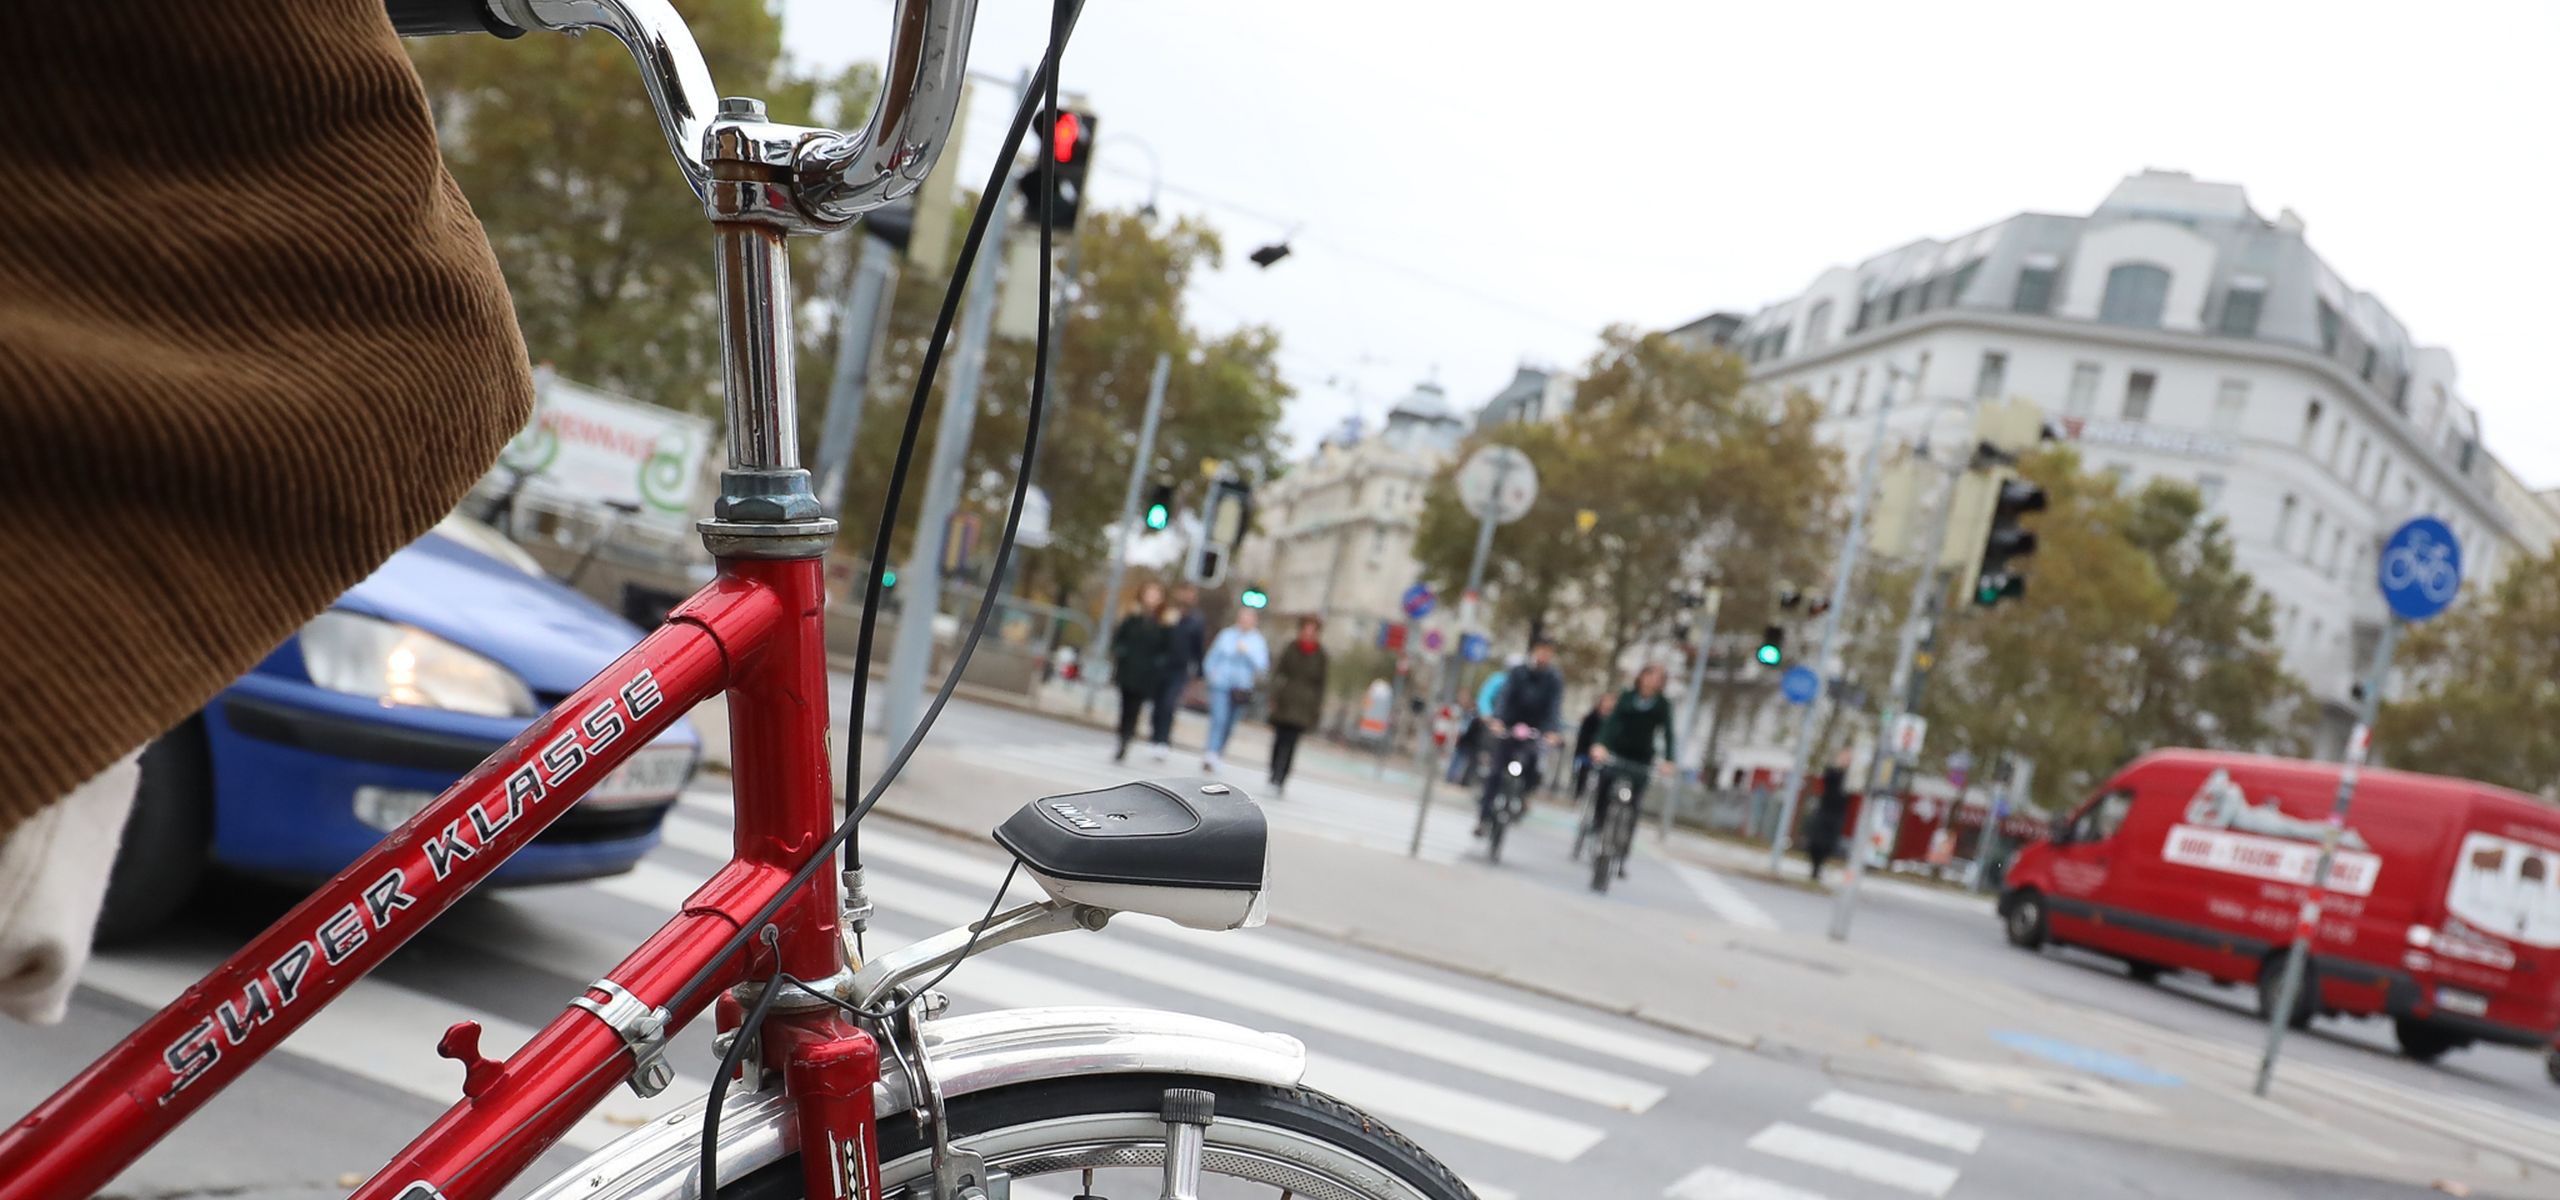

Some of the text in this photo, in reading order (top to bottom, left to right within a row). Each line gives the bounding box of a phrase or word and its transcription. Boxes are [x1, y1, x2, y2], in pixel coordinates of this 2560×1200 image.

[157, 668, 664, 1106] SUPER KLASSE
[1050, 803, 1102, 829] UNION
